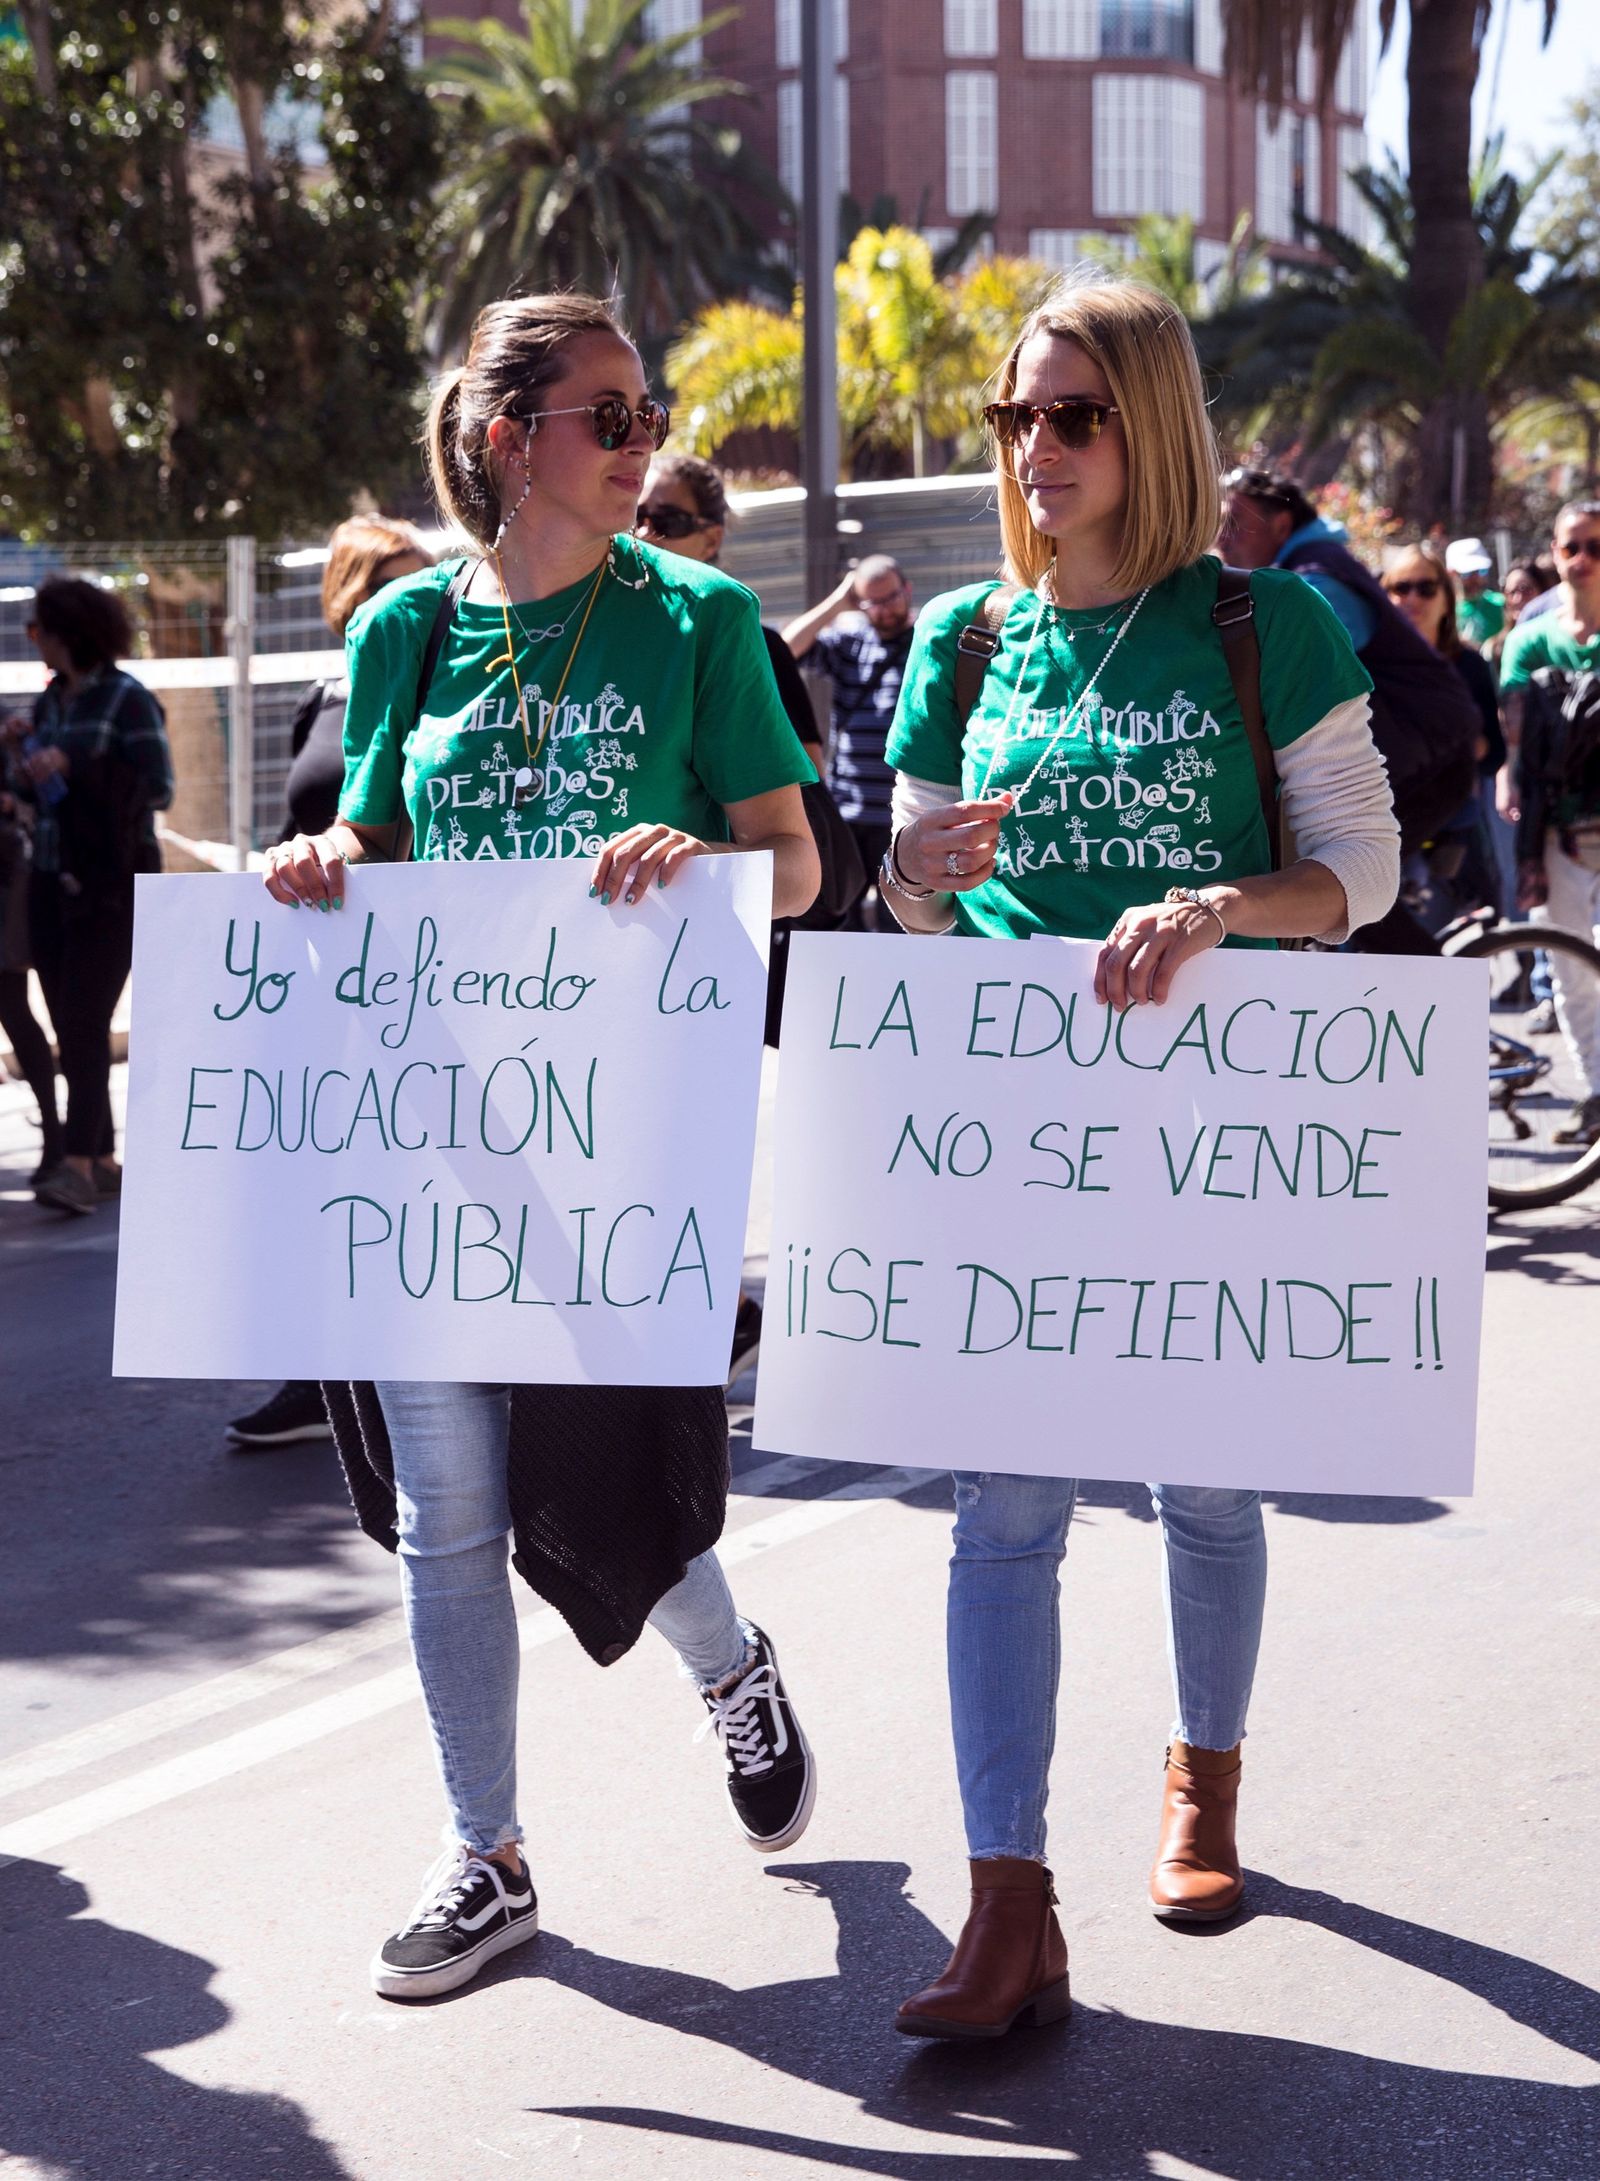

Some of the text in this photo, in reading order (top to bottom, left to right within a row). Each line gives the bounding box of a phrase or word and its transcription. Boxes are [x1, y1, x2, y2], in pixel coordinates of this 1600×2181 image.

[537, 694, 646, 740] PÚBLICA
[1101, 701, 1221, 747] PÚBLICA
[426, 772, 480, 812] DE
[1049, 775, 1197, 813] TOD@S
[504, 825, 620, 862] TOD@
[996, 840, 1066, 879] ARA
[213, 917, 297, 1022] Yo
[334, 911, 597, 1050] defiendo
[829, 975, 1436, 1084] LA EDUCACIÓN
[180, 1036, 598, 1160] EDUCACIÓN
[887, 1111, 1402, 1201] NO SE VENDE
[320, 1179, 714, 1311] PÚBLICA
[956, 1263, 1444, 1372] DEFIENDE!!
